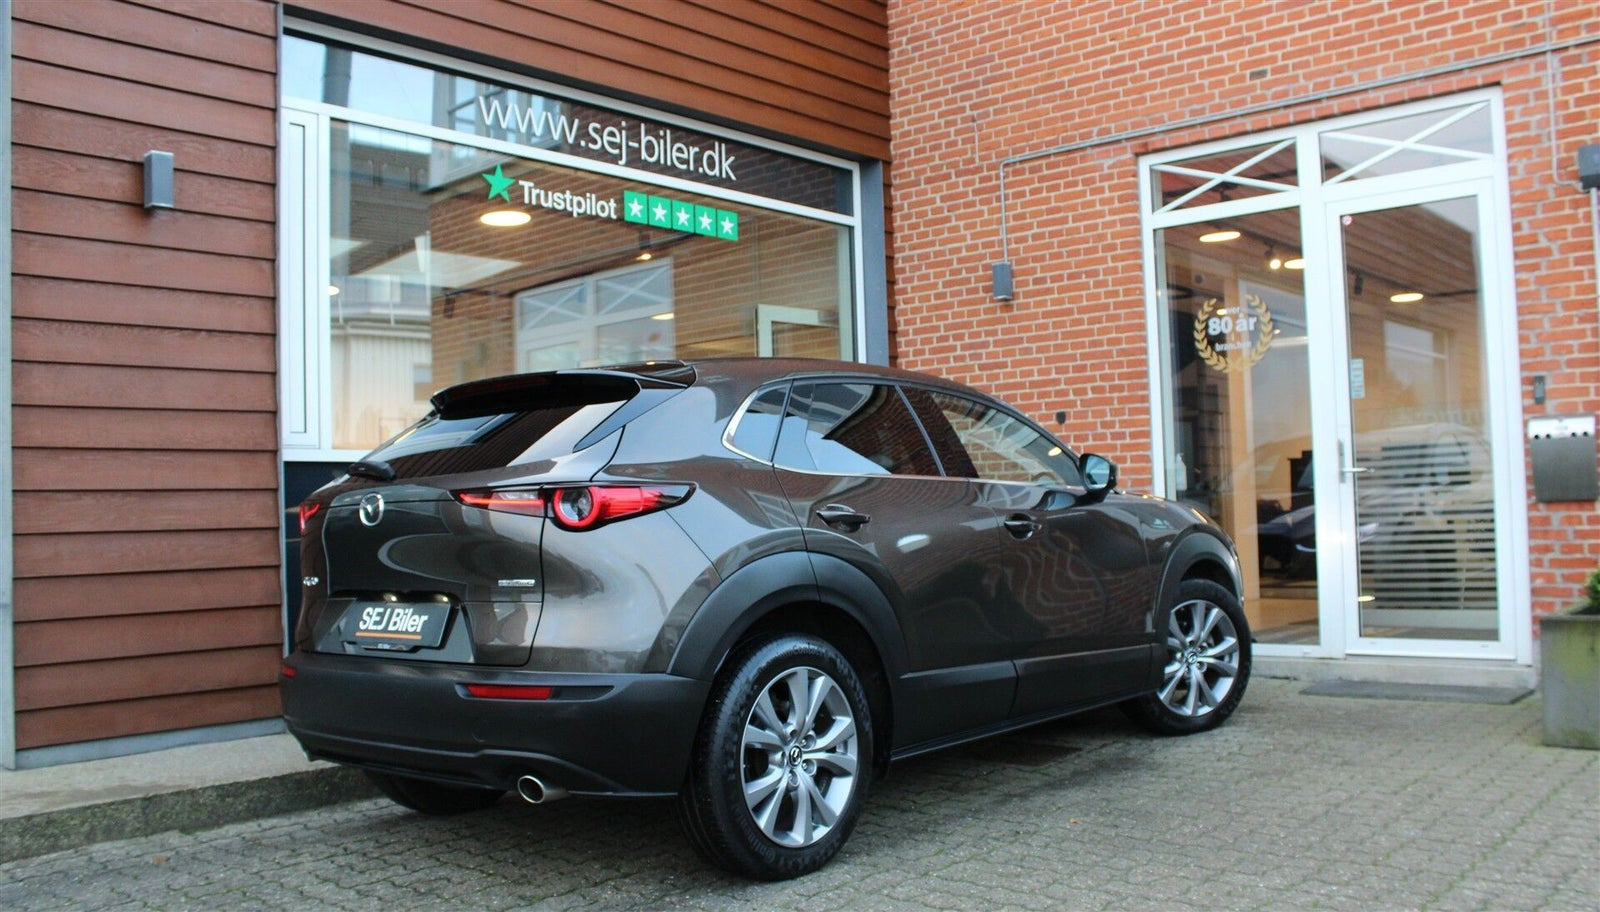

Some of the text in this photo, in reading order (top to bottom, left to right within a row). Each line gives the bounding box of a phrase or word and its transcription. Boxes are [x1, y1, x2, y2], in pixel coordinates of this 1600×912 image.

[478, 95, 737, 181] www.sej-biler.dk
[518, 179, 617, 220] Trustpilot
[1207, 316, 1233, 336] 80
[359, 606, 429, 633] SEJ Biler
